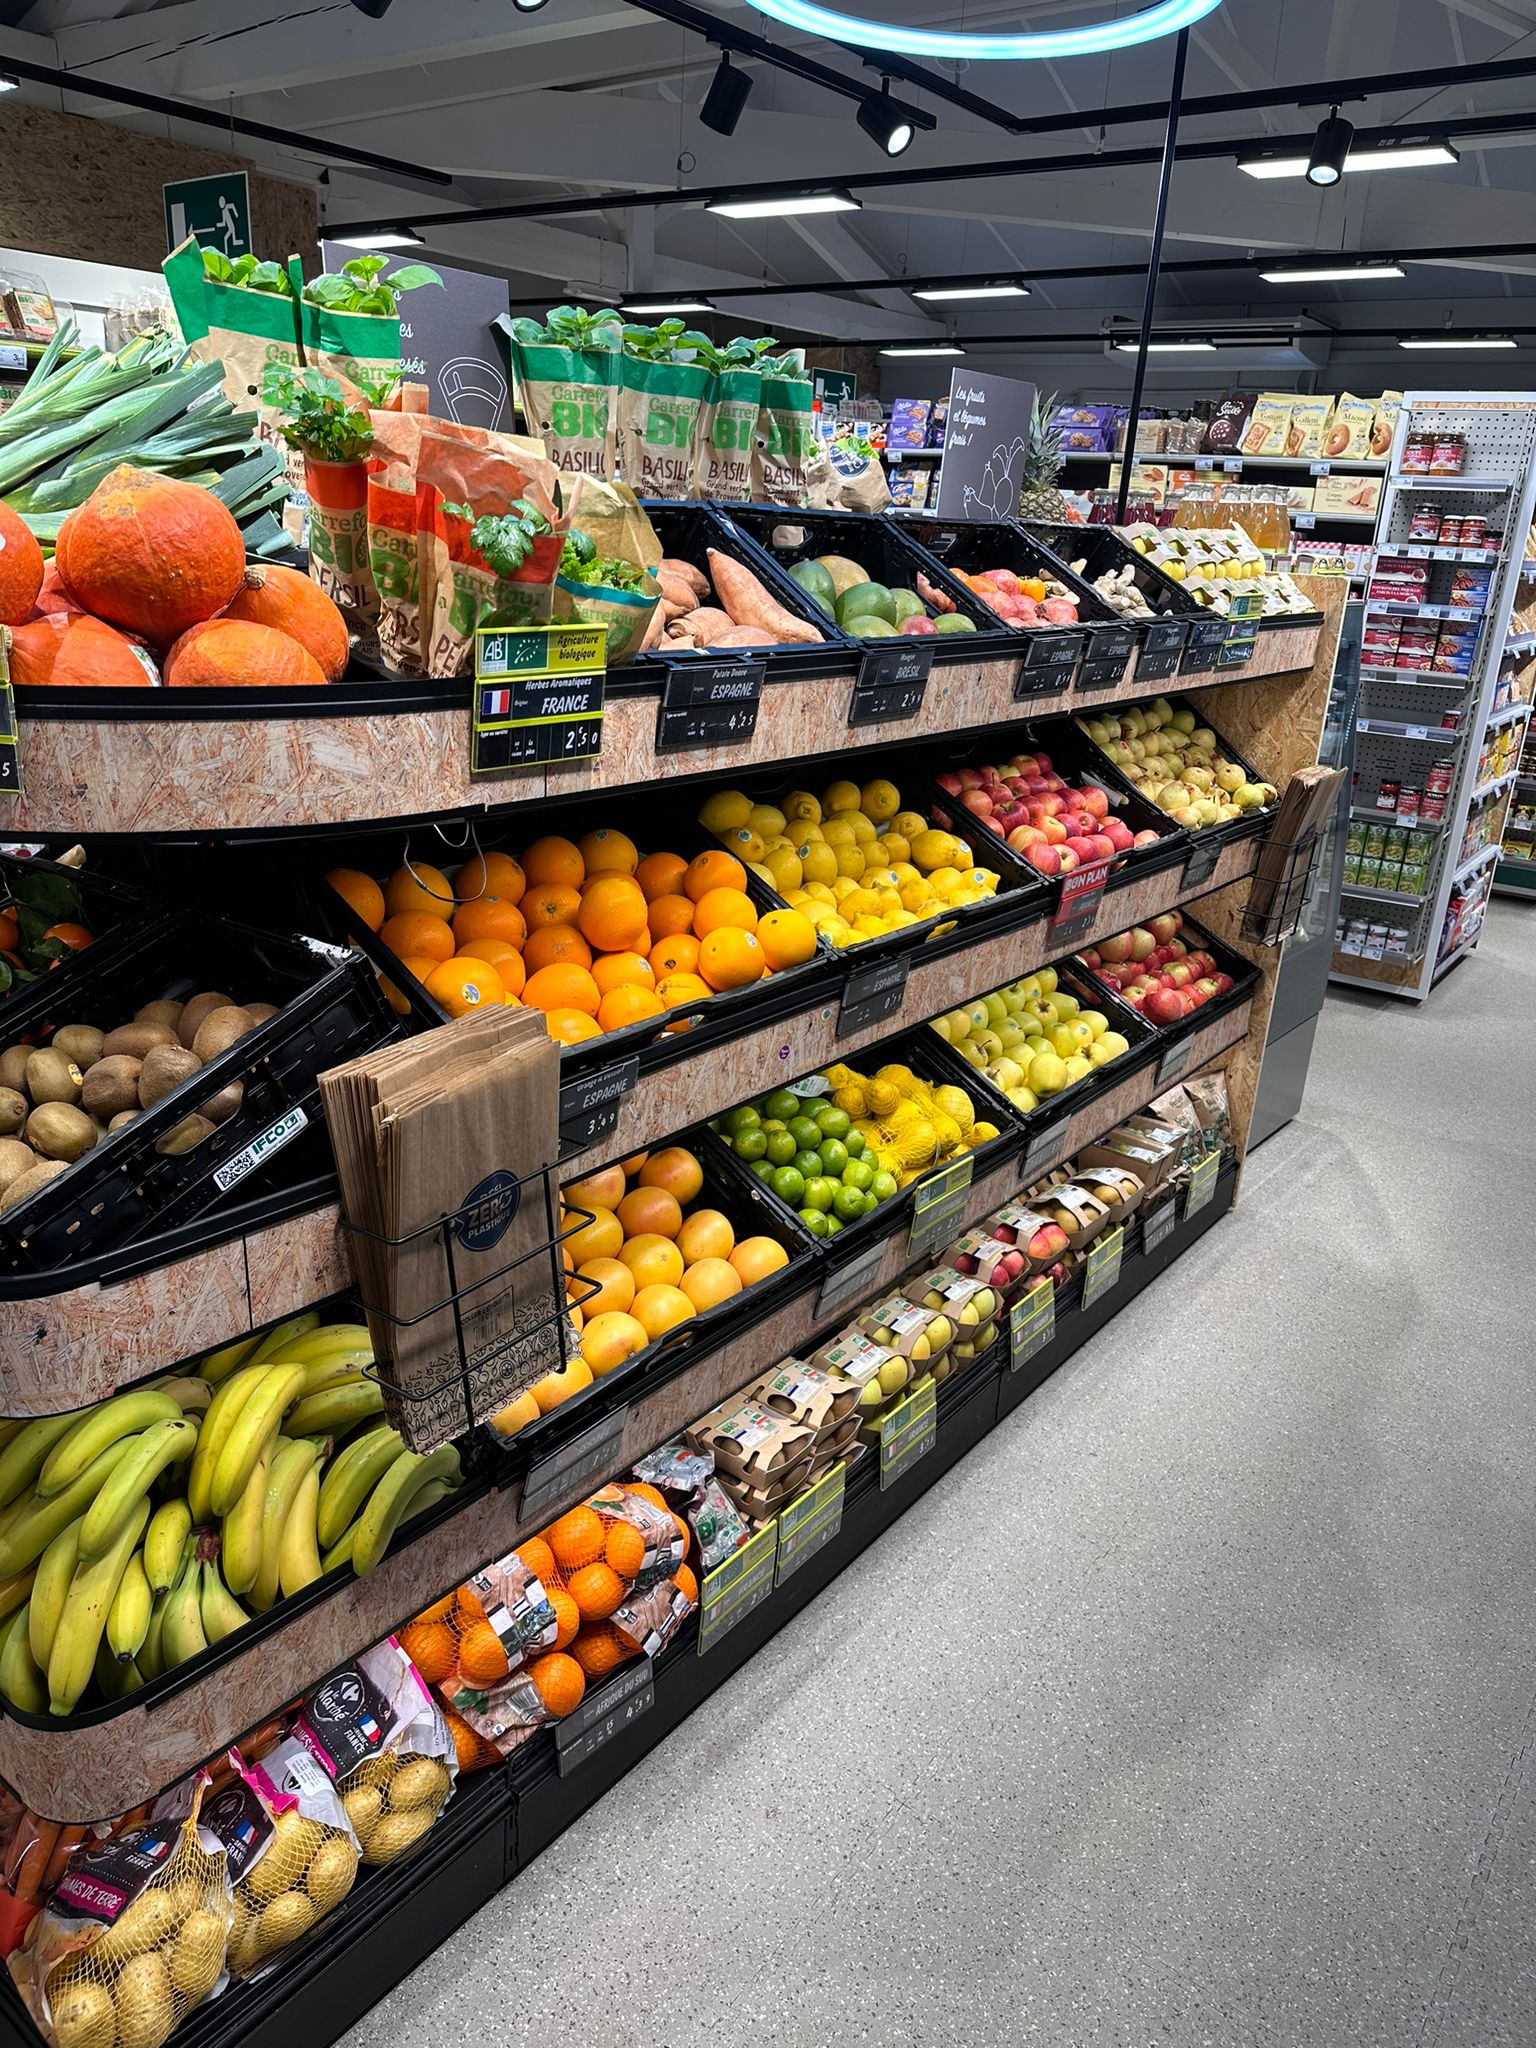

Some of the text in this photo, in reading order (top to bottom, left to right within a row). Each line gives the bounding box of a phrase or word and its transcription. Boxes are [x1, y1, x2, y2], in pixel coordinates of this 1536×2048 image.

[649, 397, 697, 415] Carref
[956, 386, 985, 406] Les fruits
[961, 409, 986, 430] légumes
[557, 634, 599, 648] Agriculture
[559, 648, 596, 661] biologique
[525, 676, 592, 691] Herbes Aromatiques
[710, 682, 754, 699] ESPAGNE
[541, 694, 589, 714] FRANCE
[1086, 866, 1108, 885] PLAN
[583, 1078, 628, 1108] ESPAGNE
[252, 1125, 285, 1155] IFCO
[468, 1208, 511, 1239] PLASTIQUE
[596, 1669, 648, 1716] AFRIQUE DU SUD
[318, 1686, 349, 1722] Marché
[81, 1883, 95, 1900] DE
[94, 1890, 122, 1909] TERRE
